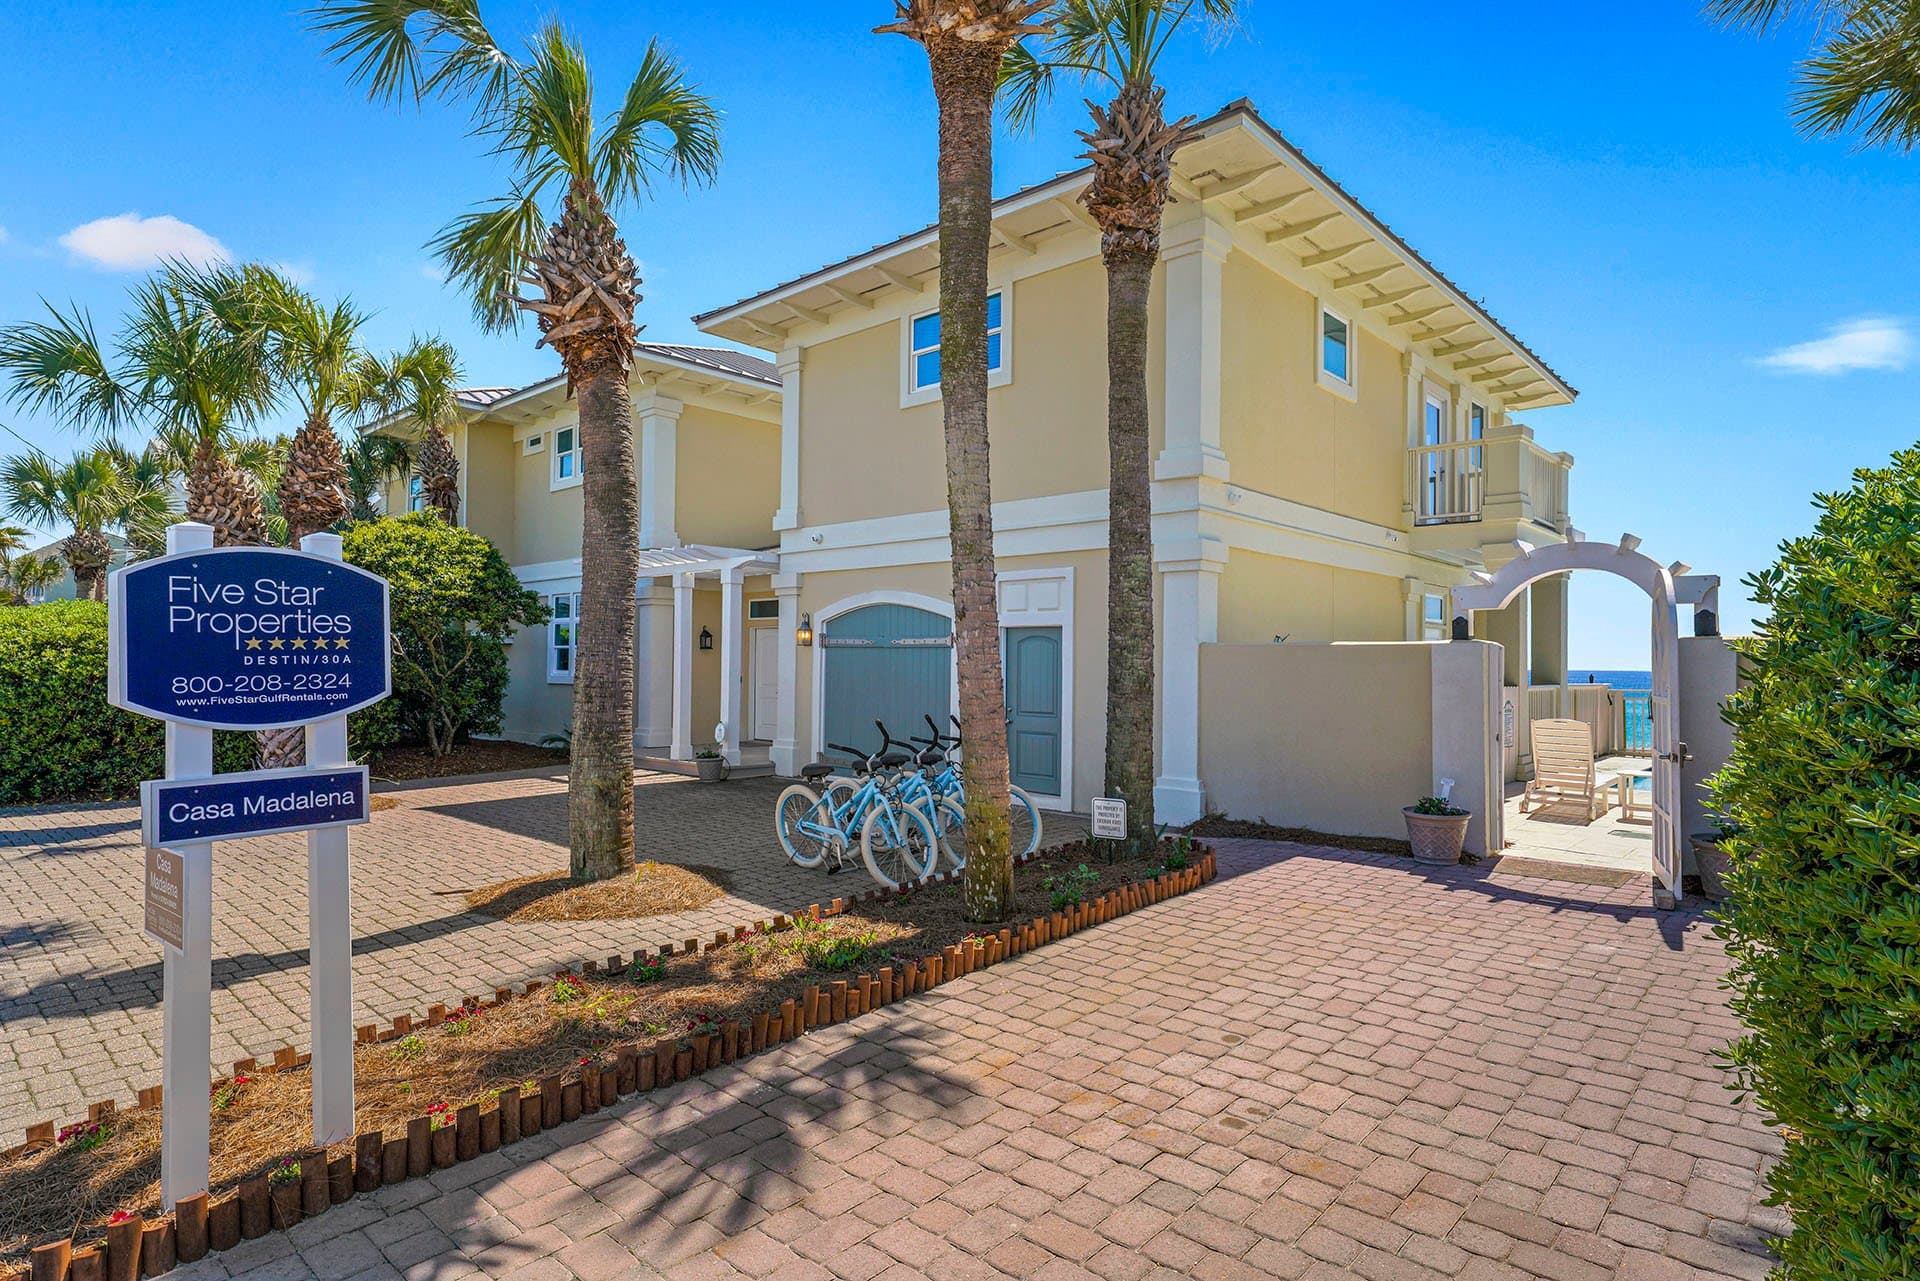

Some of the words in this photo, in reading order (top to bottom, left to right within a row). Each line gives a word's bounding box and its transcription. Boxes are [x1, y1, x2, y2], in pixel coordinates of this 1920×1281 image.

[168, 575, 245, 604] Five
[254, 578, 325, 606] Star
[169, 605, 352, 650] Properties
[244, 655, 351, 665] DESTIN/30A
[171, 673, 352, 694] 800-208-2324
[176, 692, 348, 706] www.FiveStarGulfRentals.com
[169, 803, 235, 823] Casa
[243, 791, 355, 816] Madalena
[156, 854, 172, 874] Casa
[150, 871, 178, 899] Madalena
